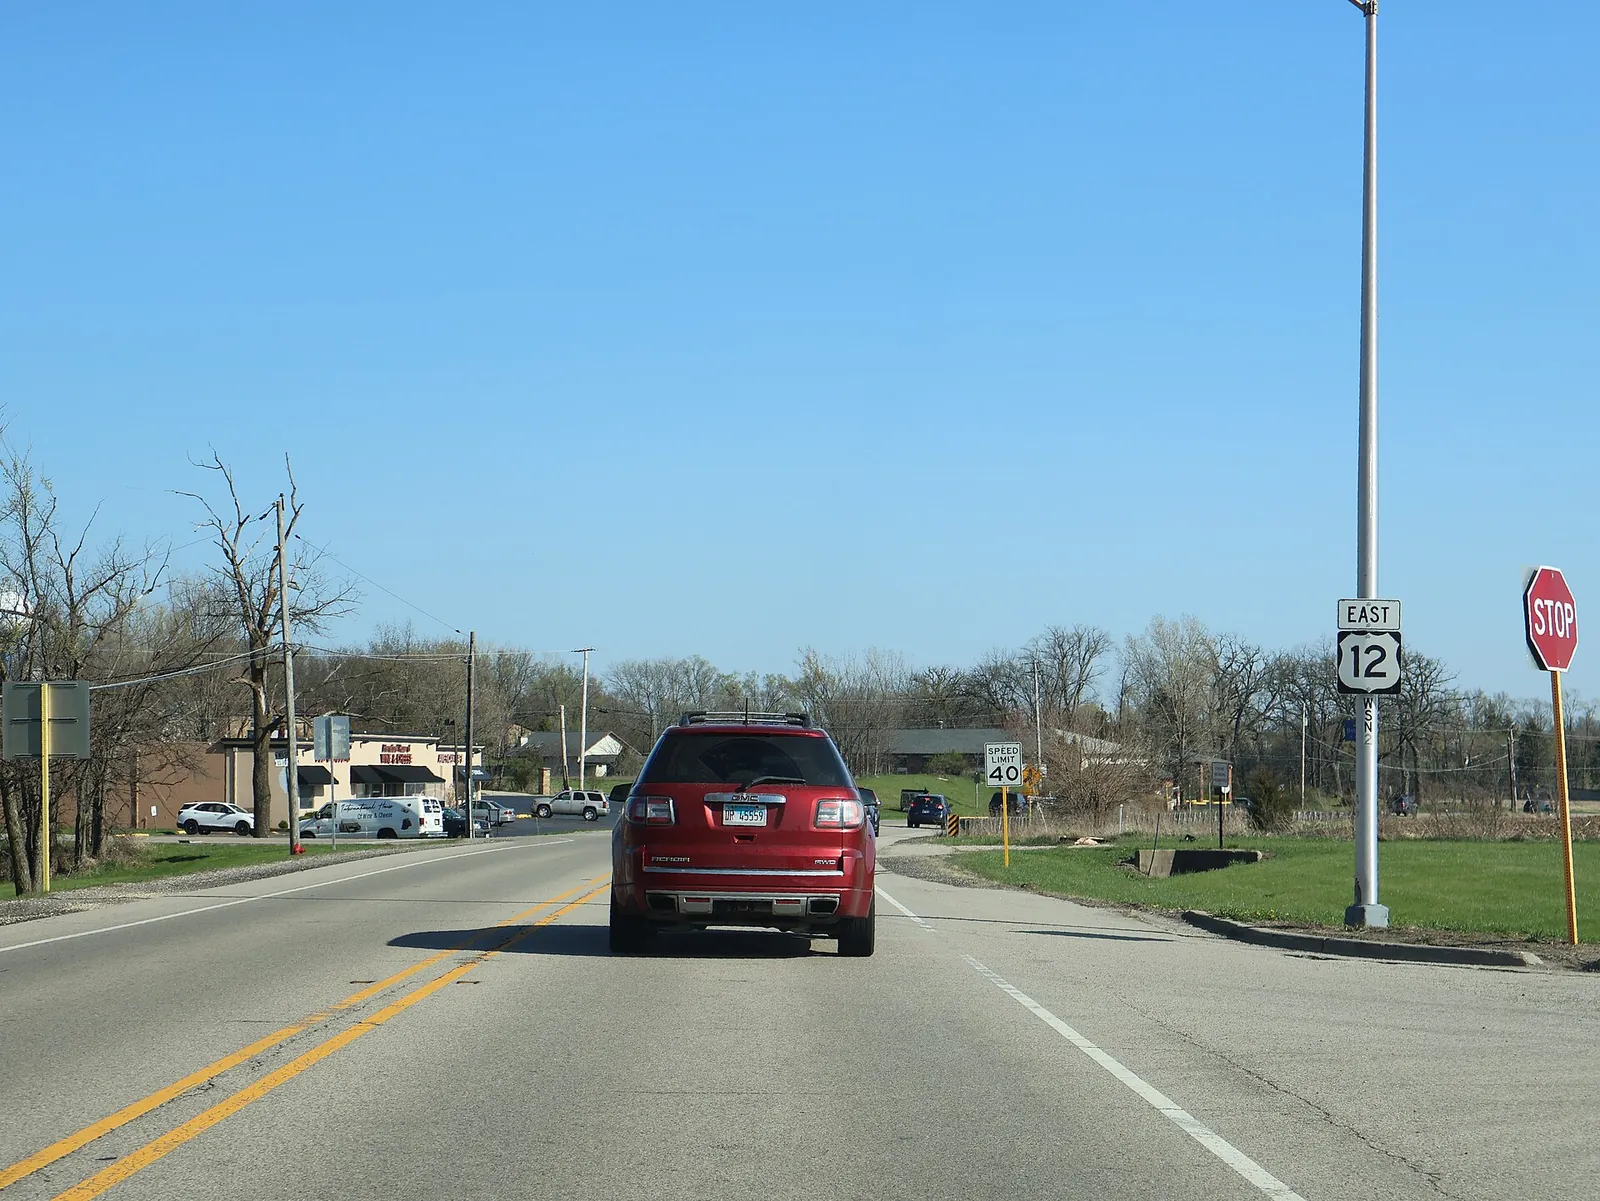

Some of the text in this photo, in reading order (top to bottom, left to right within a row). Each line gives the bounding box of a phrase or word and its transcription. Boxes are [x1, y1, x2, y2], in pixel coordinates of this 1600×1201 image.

[1347, 605, 1390, 623] EAST
[1534, 598, 1574, 639] STOP
[1350, 644, 1387, 678] 12
[988, 747, 1018, 755] SPEED
[989, 766, 1019, 781] 40
